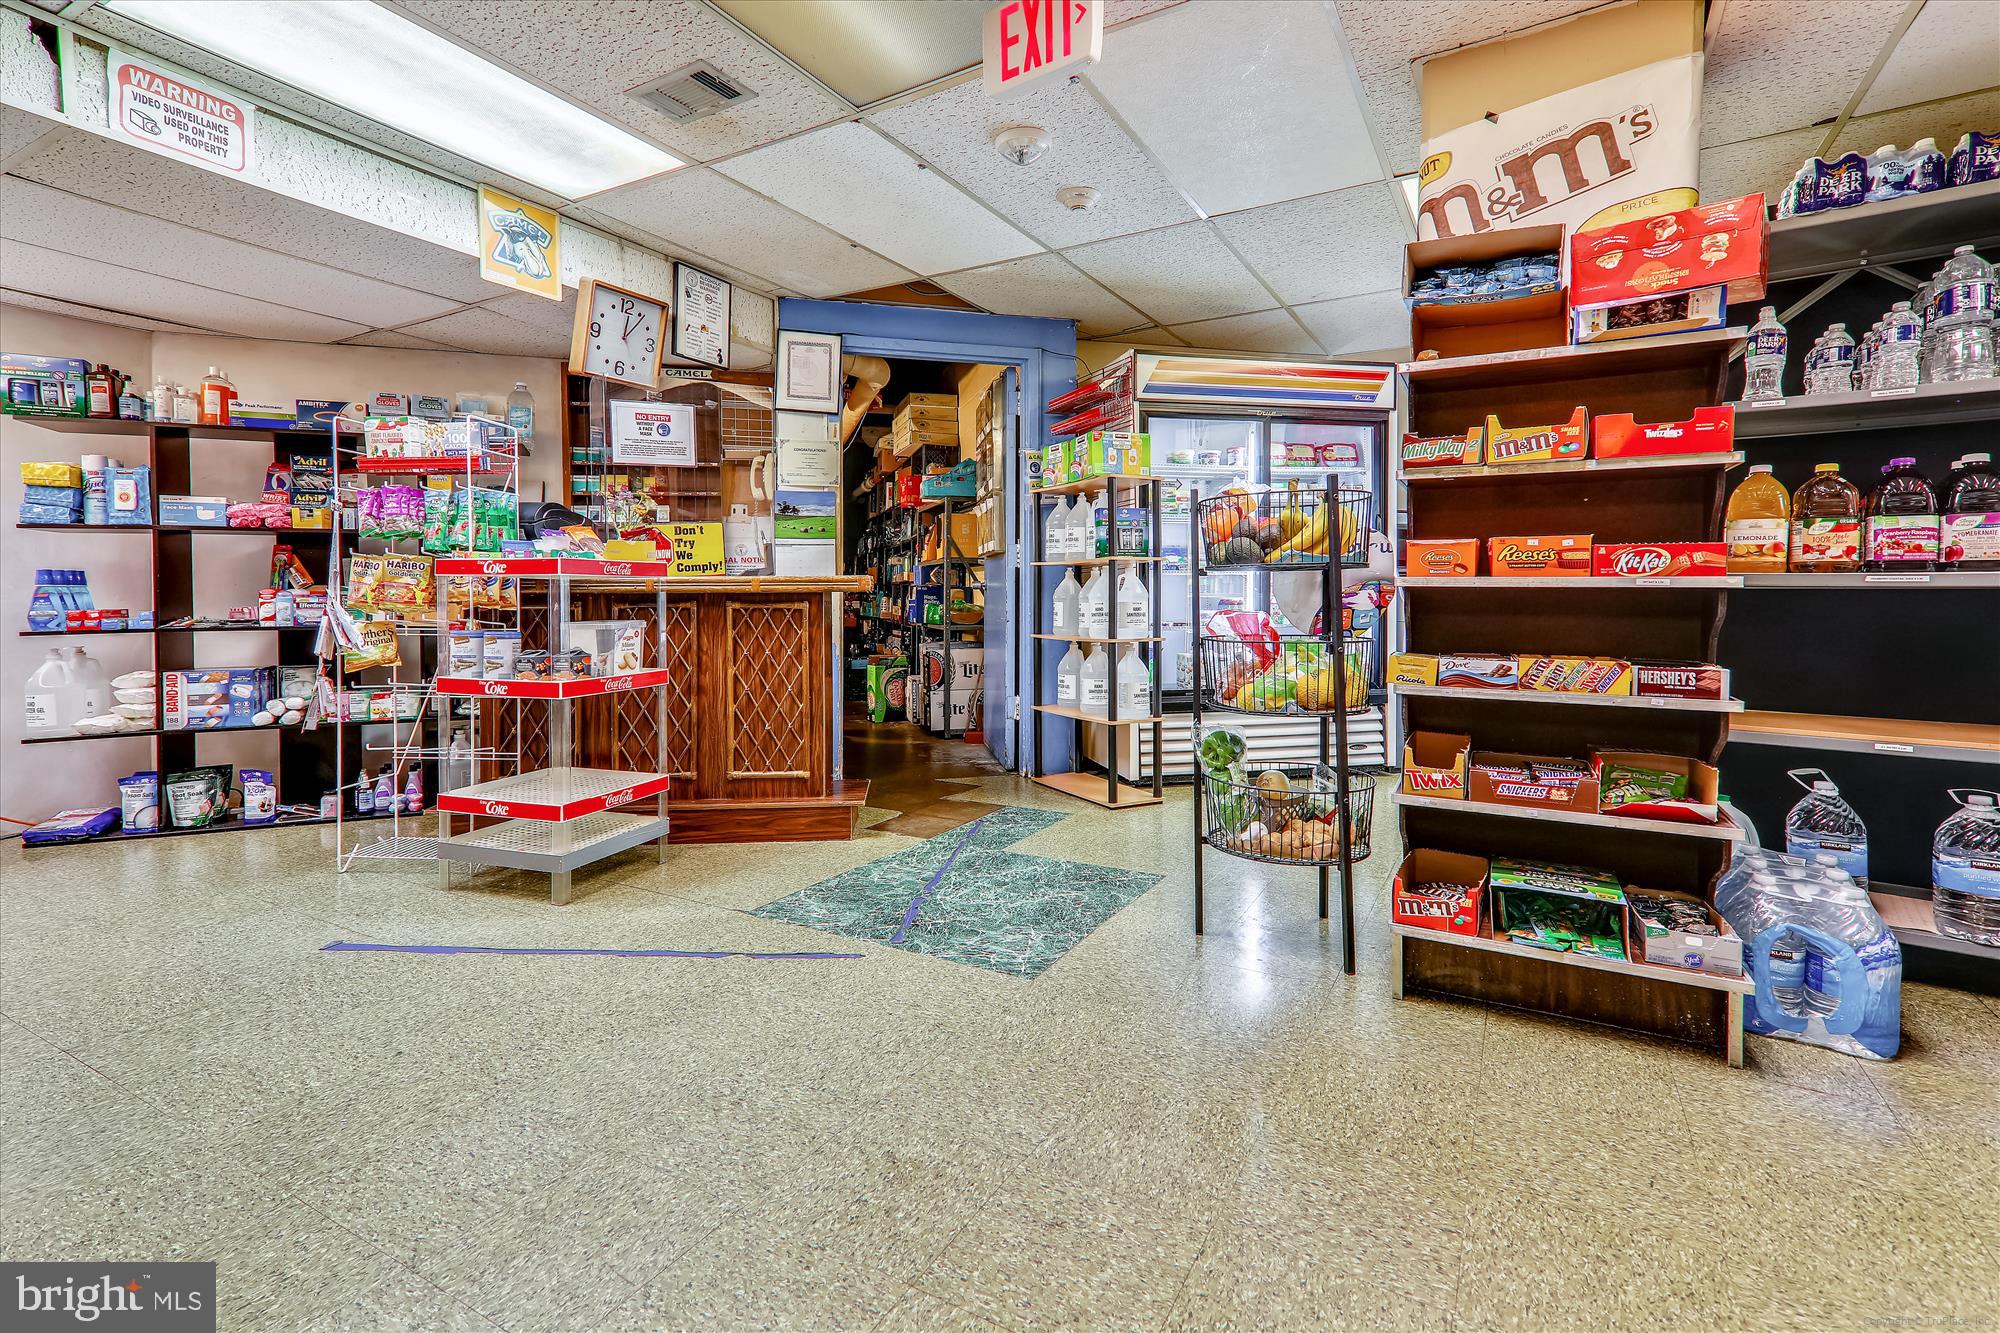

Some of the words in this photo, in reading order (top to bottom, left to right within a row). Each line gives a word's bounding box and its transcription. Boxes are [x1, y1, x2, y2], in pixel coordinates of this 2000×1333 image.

[129, 67, 237, 122] WARNING
[131, 90, 161, 110] VIDEO
[163, 103, 230, 136] SURVEILLANCE
[164, 115, 189, 132] USED
[191, 126, 205, 139] ON
[207, 131, 229, 147] THIS
[178, 132, 229, 159] PROPERTY
[1494, 140, 1534, 163] CHOCOLATE
[1535, 123, 1569, 143] CANDIES
[1820, 171, 1862, 187] DEER
[1819, 180, 1862, 197] PARK
[1620, 196, 1659, 213] PRICE
[494, 214, 548, 245] CAMEL
[620, 298, 635, 316] 12
[590, 322, 602, 338] 9
[645, 338, 656, 353] 3
[1757, 336, 1780, 344] DEER
[1757, 341, 1780, 349] PARK
[614, 360, 625, 376] 6
[665, 369, 709, 378] CAMEL
[297, 400, 330, 409] AMBITEX
[647, 414, 670, 423] ENTRY
[447, 433, 468, 444] 100
[1643, 427, 1684, 439] Twizzlers
[1469, 439, 1479, 449] 2
[1494, 432, 1559, 460] m&m's
[297, 458, 328, 467] Advil
[261, 493, 288, 501] WRIST
[294, 493, 324, 502] Advil
[673, 525, 704, 537] Don't
[1883, 529, 1911, 538] Cranberry
[1911, 529, 1938, 538] Raspberry
[1957, 529, 1999, 538] POMEGRANATE
[674, 538, 696, 551] Try
[1811, 536, 1832, 544] 100%
[675, 550, 693, 560] We
[1424, 551, 1454, 562] Reese's
[1496, 544, 1558, 562] Reese's
[386, 559, 426, 571] HARIBO
[483, 560, 507, 575] Coke
[603, 562, 633, 576] Coca-Cola
[676, 561, 724, 574] Comply!
[388, 570, 422, 578] Goldbears
[1441, 660, 1471, 670] Dove
[604, 676, 633, 692] Coca-Cola
[1395, 674, 1426, 685] Ricola
[1597, 666, 1621, 693] SNICKERS
[1639, 669, 1697, 686] HERSHEY'S
[165, 673, 179, 714] BAND-AID
[484, 680, 508, 696] Coke
[1498, 784, 1547, 798] SNICKERS
[605, 789, 634, 807] Coca-Cola
[485, 800, 509, 816] Coke
[1821, 841, 1851, 850] KIRKLAND
[1972, 860, 2000, 869] KIRKLAN
[1398, 898, 1460, 918] m&m's
[1685, 954, 1702, 967] York
